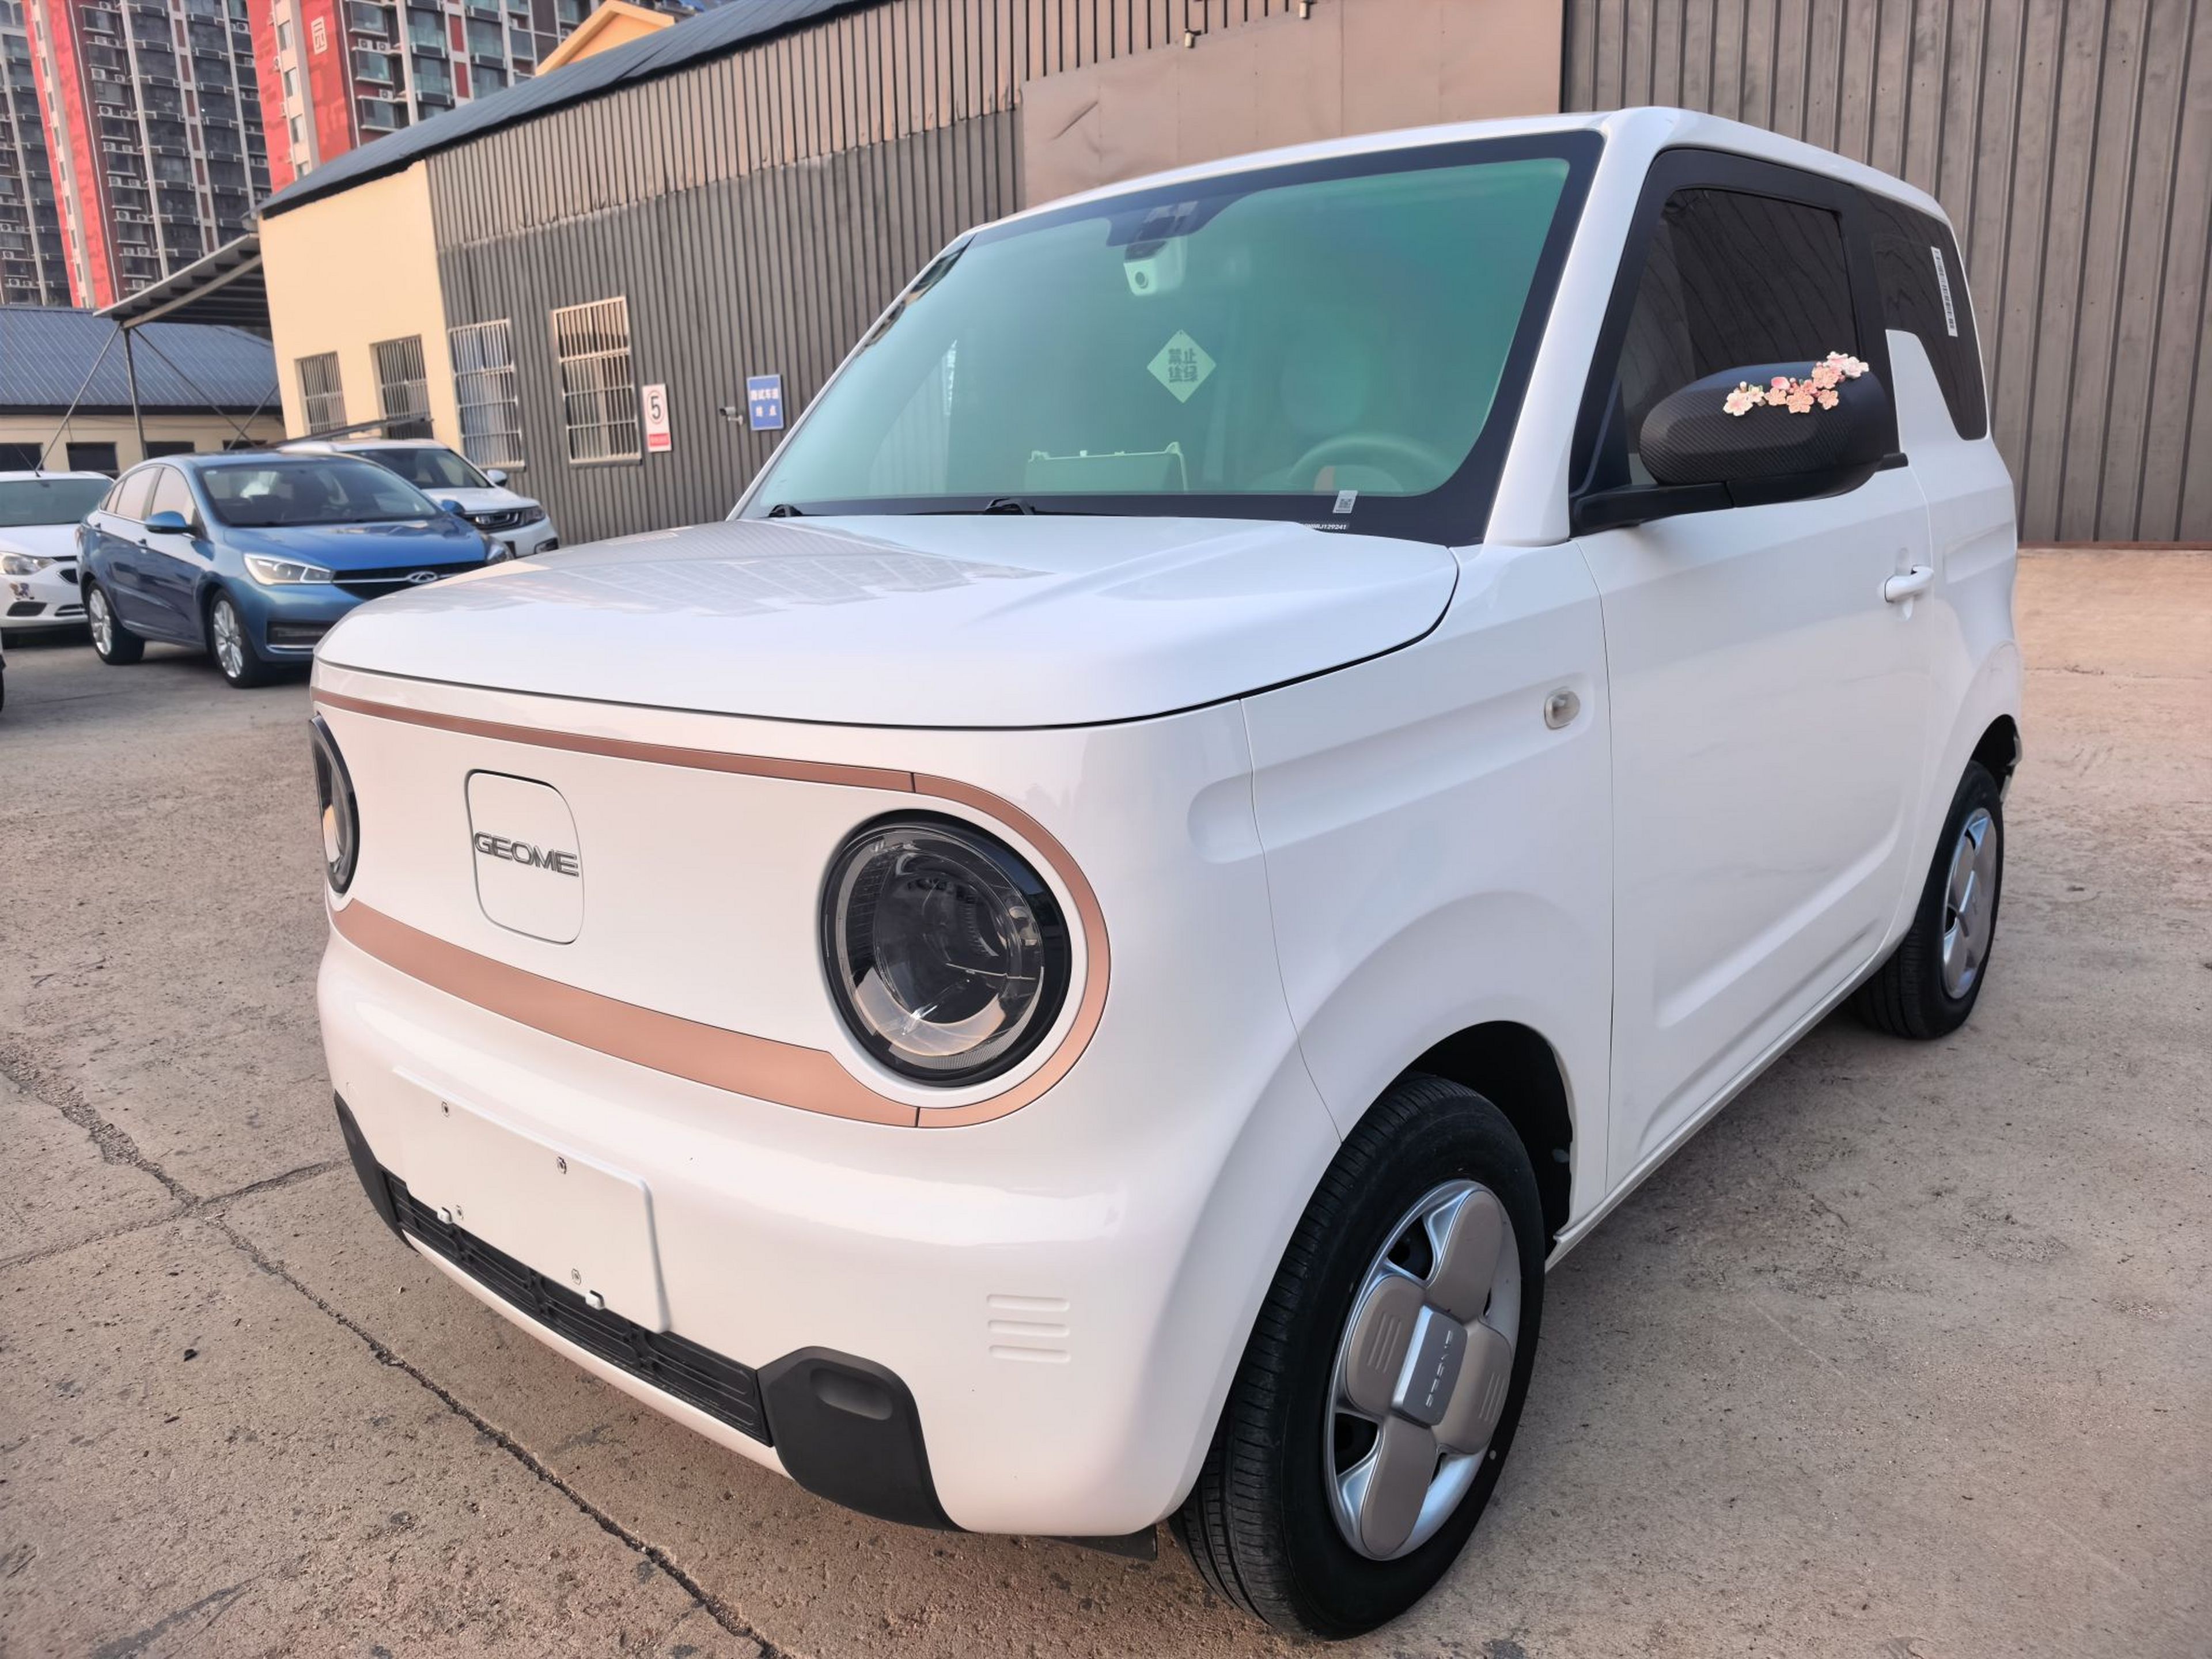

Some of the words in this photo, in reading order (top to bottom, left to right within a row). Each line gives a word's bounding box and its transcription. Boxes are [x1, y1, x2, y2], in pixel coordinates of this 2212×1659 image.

[1168, 347, 1197, 365] 禁止
[650, 396, 661, 419] 5
[474, 831, 579, 877] GEOME
